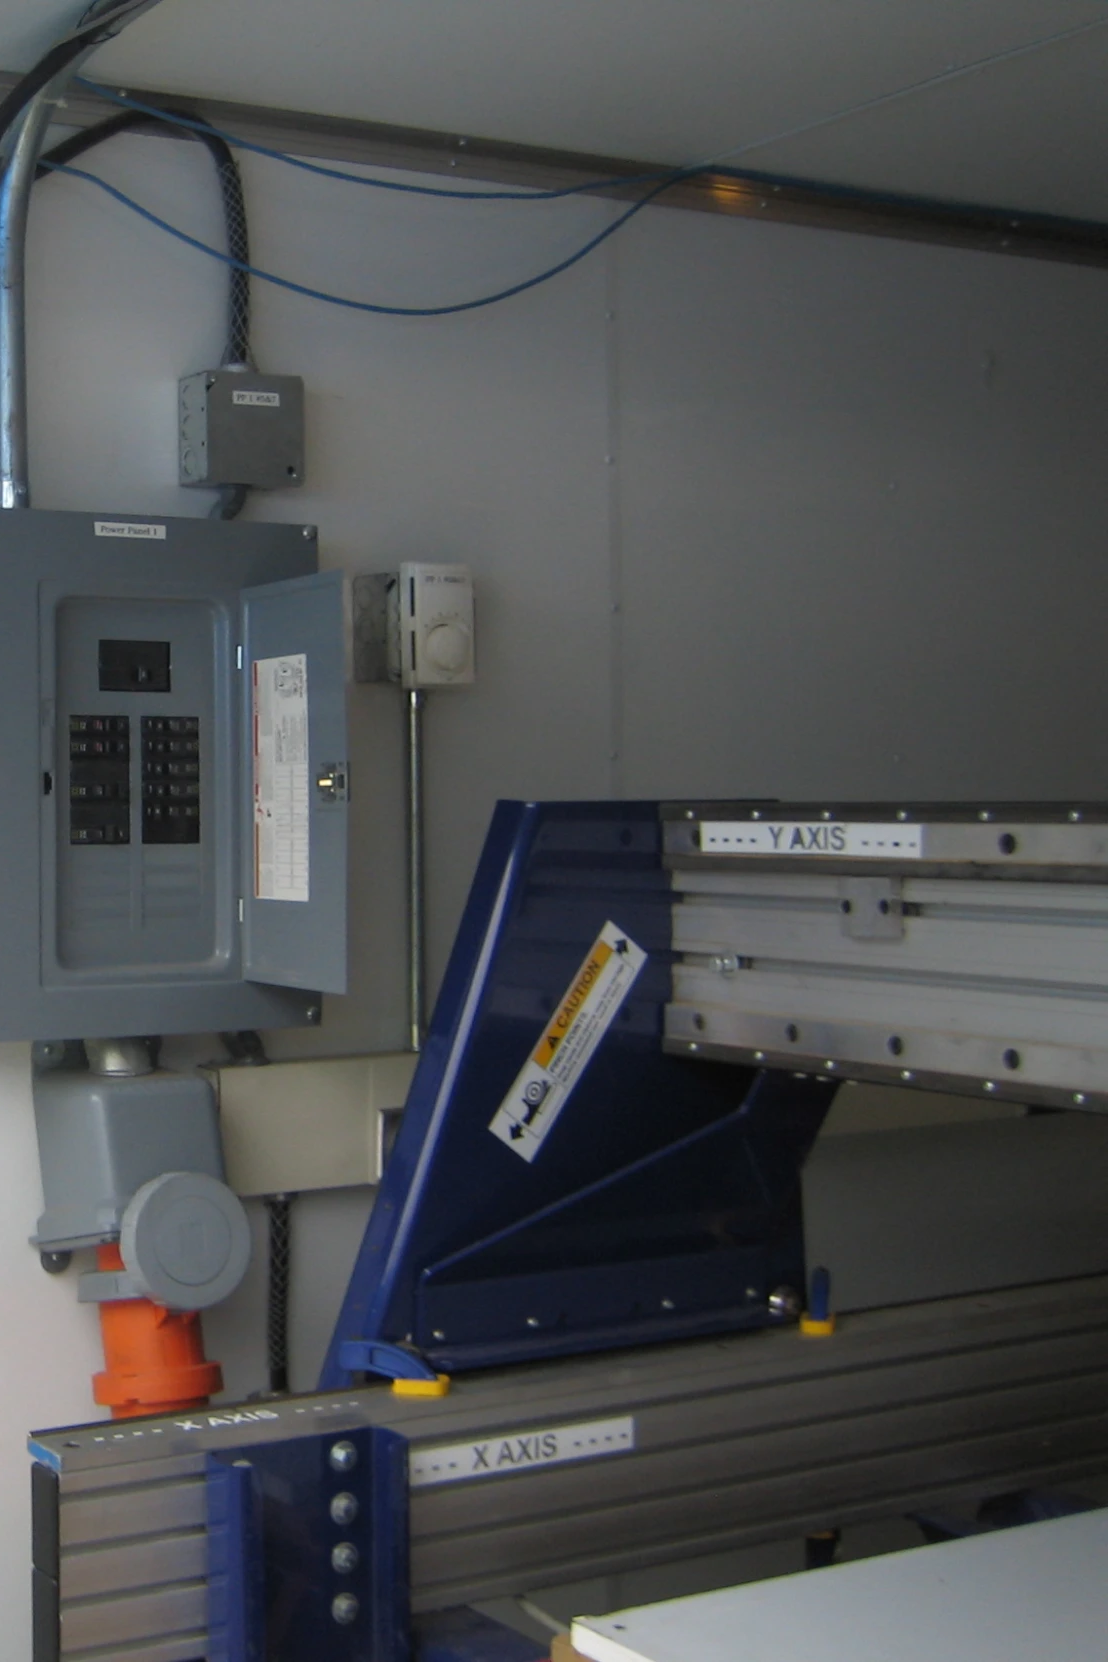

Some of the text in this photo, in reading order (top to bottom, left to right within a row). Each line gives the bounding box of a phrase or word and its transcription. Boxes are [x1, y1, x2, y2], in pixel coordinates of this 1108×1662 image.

[100, 525, 125, 535] Power
[127, 525, 150, 536] Panel
[768, 826, 846, 851] Y AXIS
[557, 960, 600, 1028] CAUTION
[550, 1043, 568, 1073] PINCH
[566, 1012, 588, 1044] POINTS
[173, 1409, 280, 1431] X AXIS
[472, 1432, 558, 1470] X AXIS
